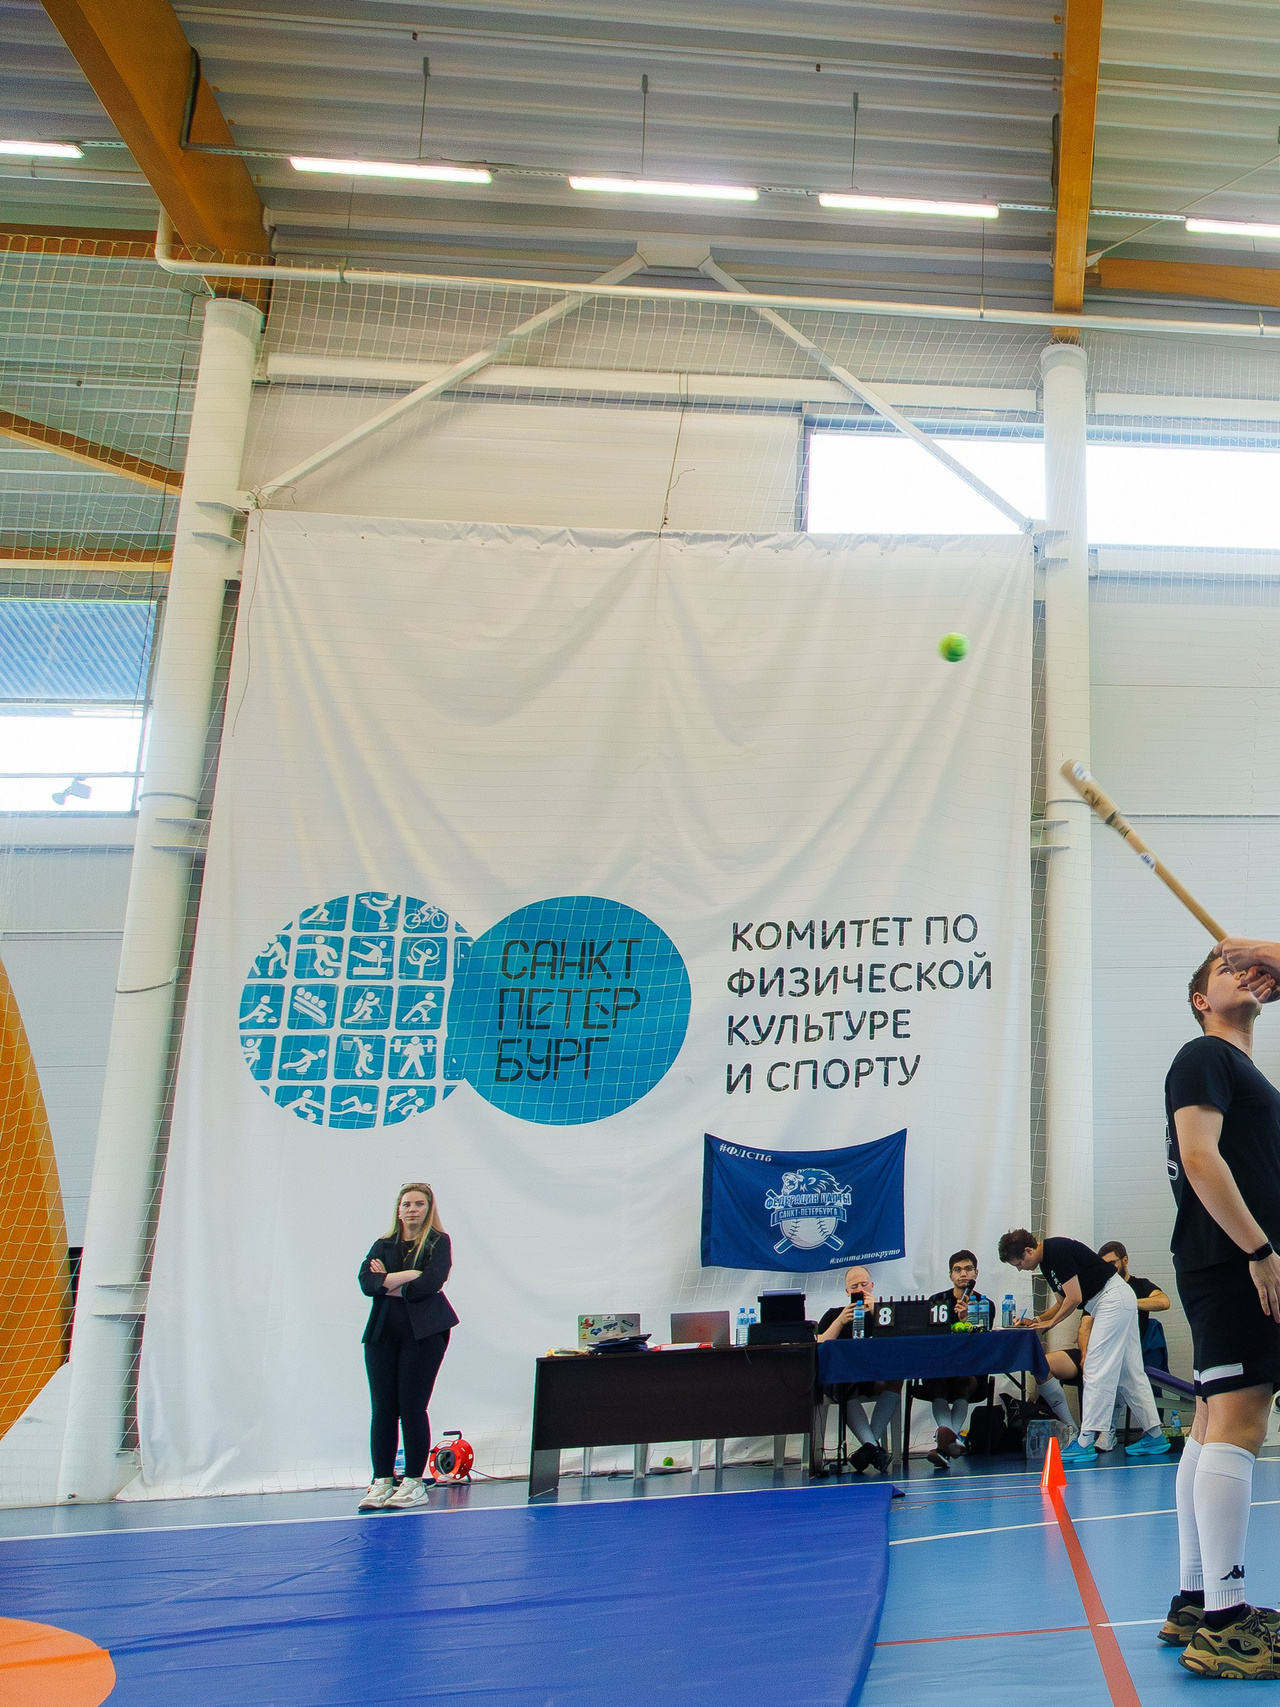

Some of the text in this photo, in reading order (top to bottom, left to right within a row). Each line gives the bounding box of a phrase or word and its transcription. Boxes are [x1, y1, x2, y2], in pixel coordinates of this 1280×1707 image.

[731, 913, 978, 951] КОМИТЕТ ПО
[501, 939, 642, 980] САНКТ
[727, 951, 992, 997] ФИЗИЧЕСКОЙ
[498, 987, 641, 1030] ПЕТЕР
[727, 1009, 912, 1046] КУЛЬТУРЕ
[495, 1037, 610, 1082] БУРГ
[726, 1054, 921, 1094] И СПОРТУ
[778, 1207, 838, 1219] САНКТ-ПЕТЕРБУРГА
[878, 1304, 948, 1326] 8 16
